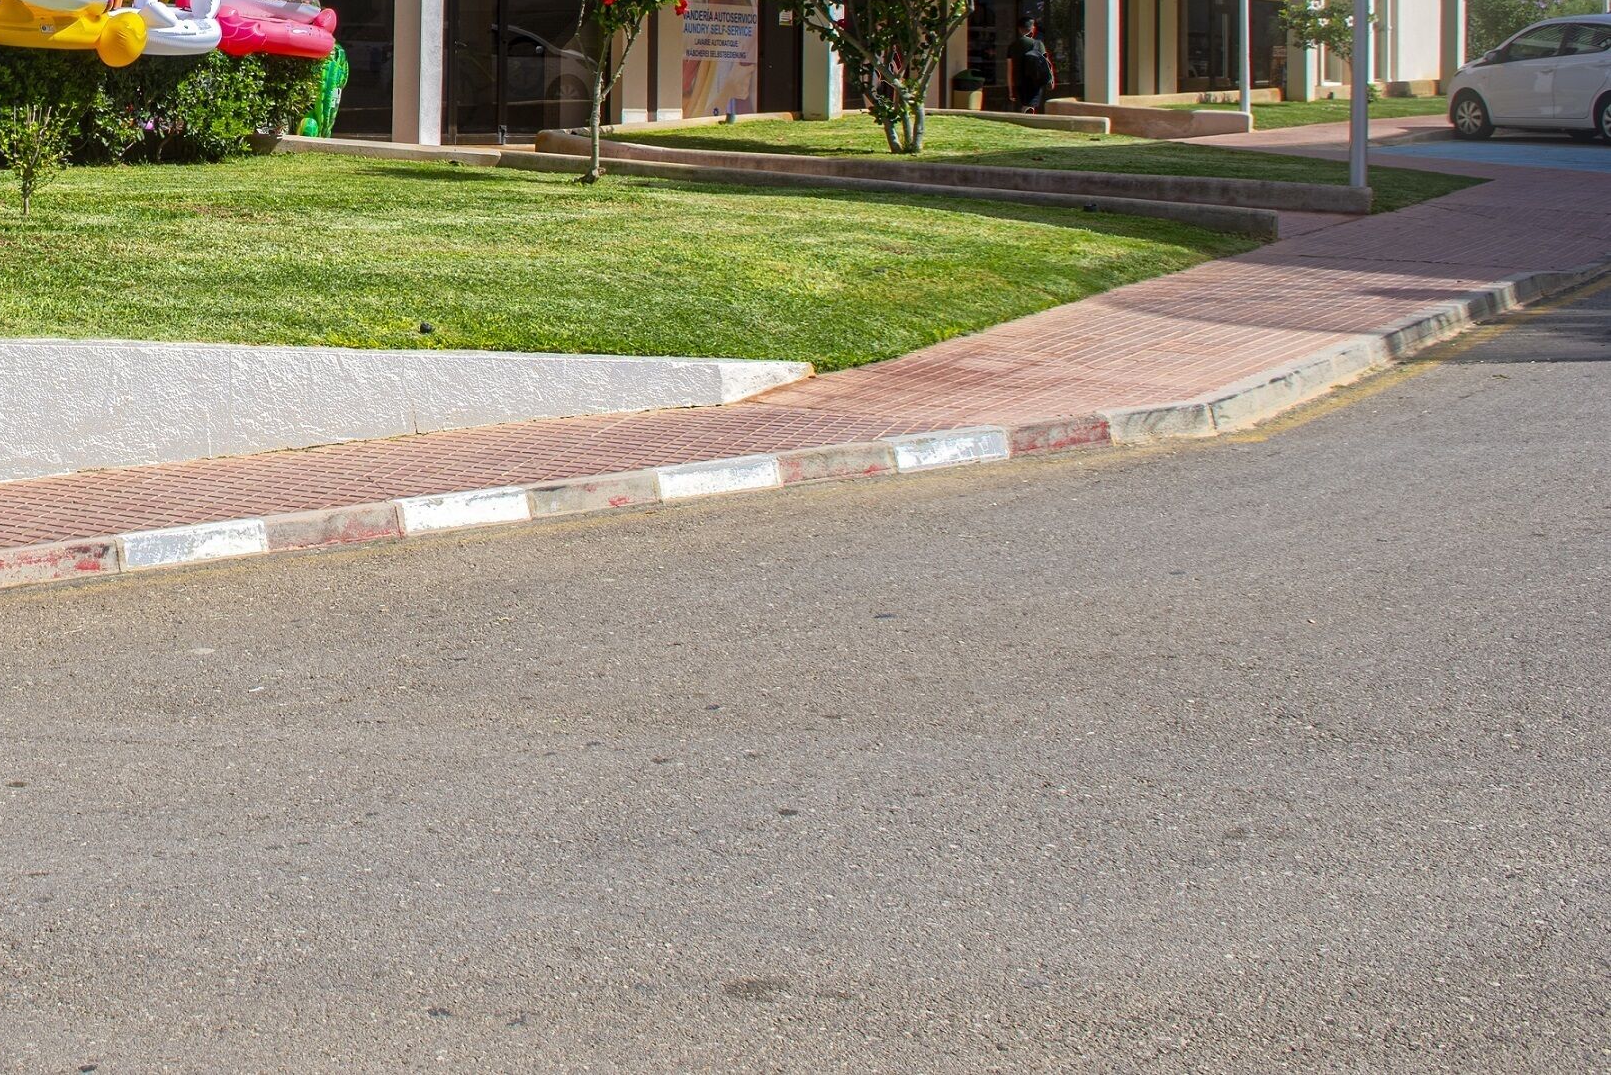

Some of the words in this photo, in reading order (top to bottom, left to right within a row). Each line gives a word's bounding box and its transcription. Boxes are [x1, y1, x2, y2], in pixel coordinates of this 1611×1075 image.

[683, 9, 714, 22] VANDERÍA
[683, 23, 709, 34] AUNDRY
[710, 24, 752, 37] SELF-SERVICE
